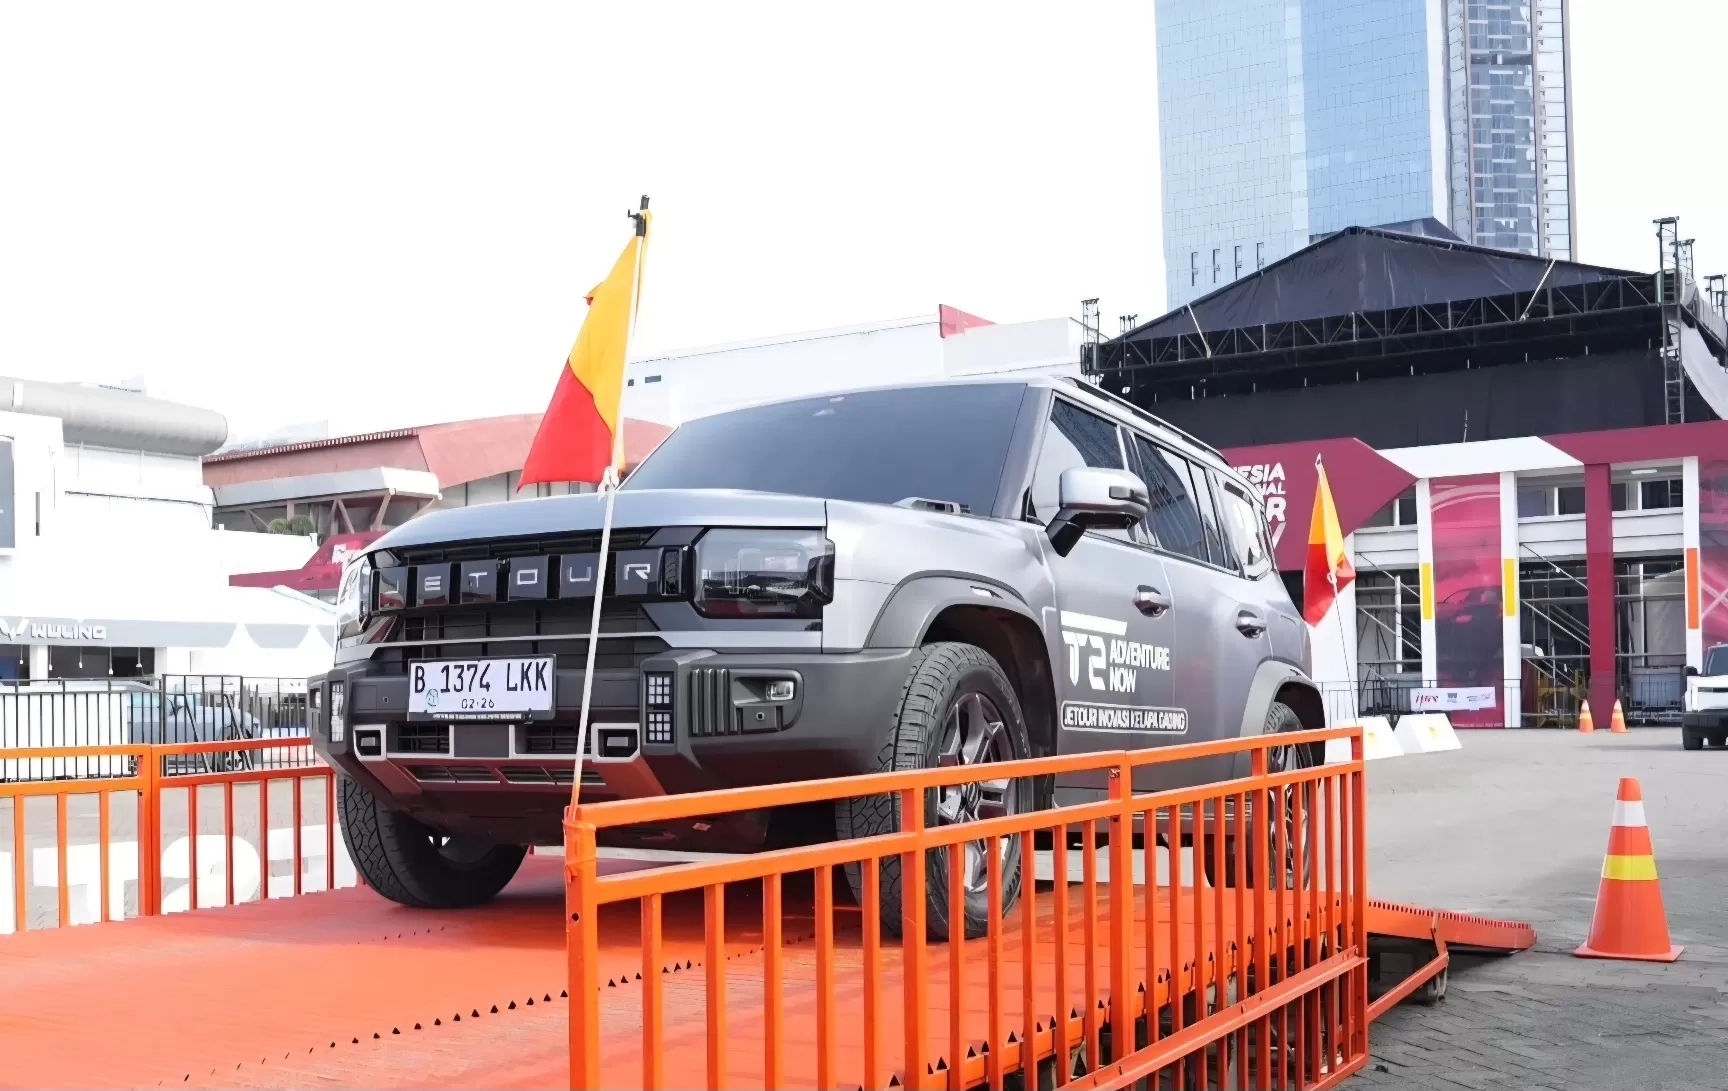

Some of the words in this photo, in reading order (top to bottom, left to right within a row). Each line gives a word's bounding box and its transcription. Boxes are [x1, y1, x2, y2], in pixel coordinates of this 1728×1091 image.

[385, 563, 651, 594] JETOUR
[31, 623, 107, 640] WULING
[1109, 639, 1170, 671] ADVENTURE
[414, 665, 425, 693] B
[440, 663, 491, 693] 1374
[506, 661, 548, 692] LKK
[1109, 666, 1137, 693] NOW
[1064, 706, 1097, 727] JETOUR
